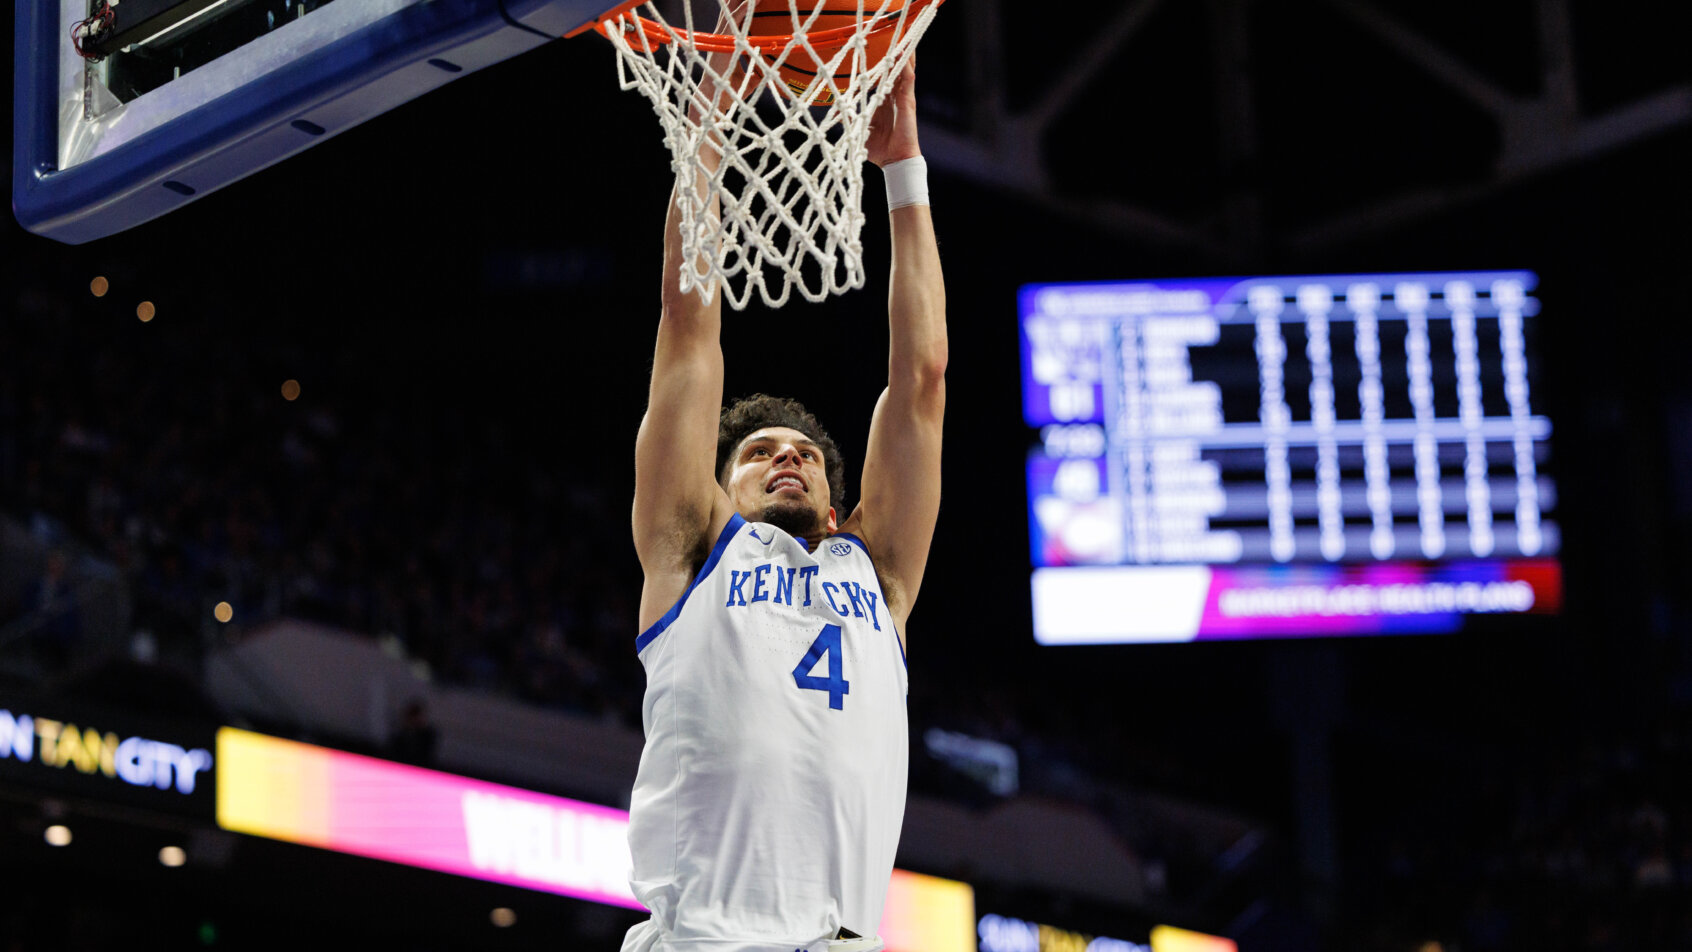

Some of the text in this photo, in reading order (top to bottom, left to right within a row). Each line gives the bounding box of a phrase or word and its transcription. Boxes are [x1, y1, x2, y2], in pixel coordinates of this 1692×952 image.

[831, 543, 852, 556] SEC
[726, 564, 881, 631] KENTCKY
[792, 624, 849, 711] 4
[34, 717, 119, 778] TAN
[115, 736, 213, 794] CITY
